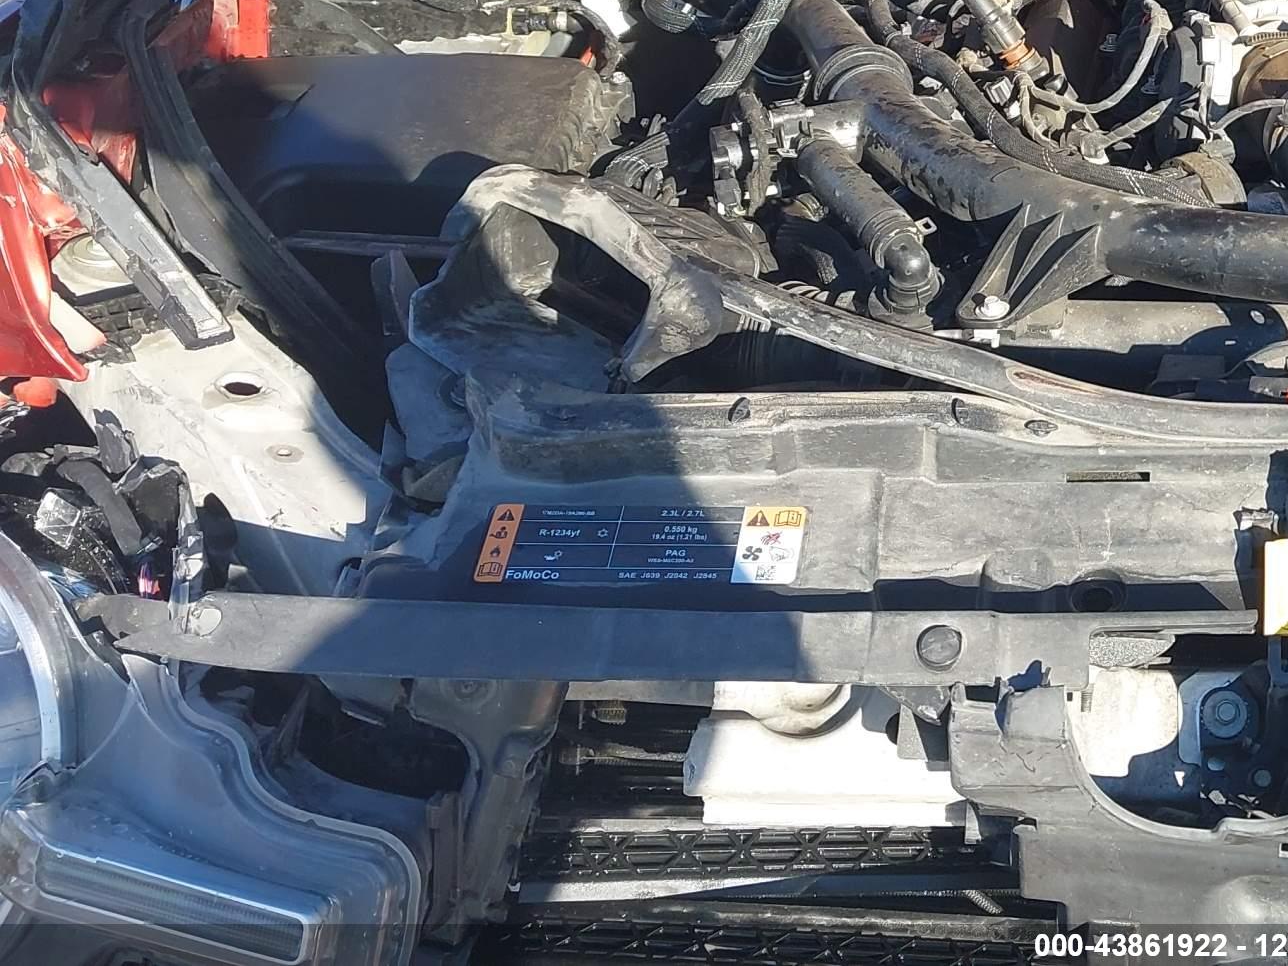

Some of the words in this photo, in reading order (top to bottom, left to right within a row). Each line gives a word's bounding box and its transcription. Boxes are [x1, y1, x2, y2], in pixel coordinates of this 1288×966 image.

[538, 528, 581, 538] R-1234yf
[687, 526, 698, 534] kg
[665, 549, 686, 557] PAG
[505, 569, 560, 580] FoMoCo
